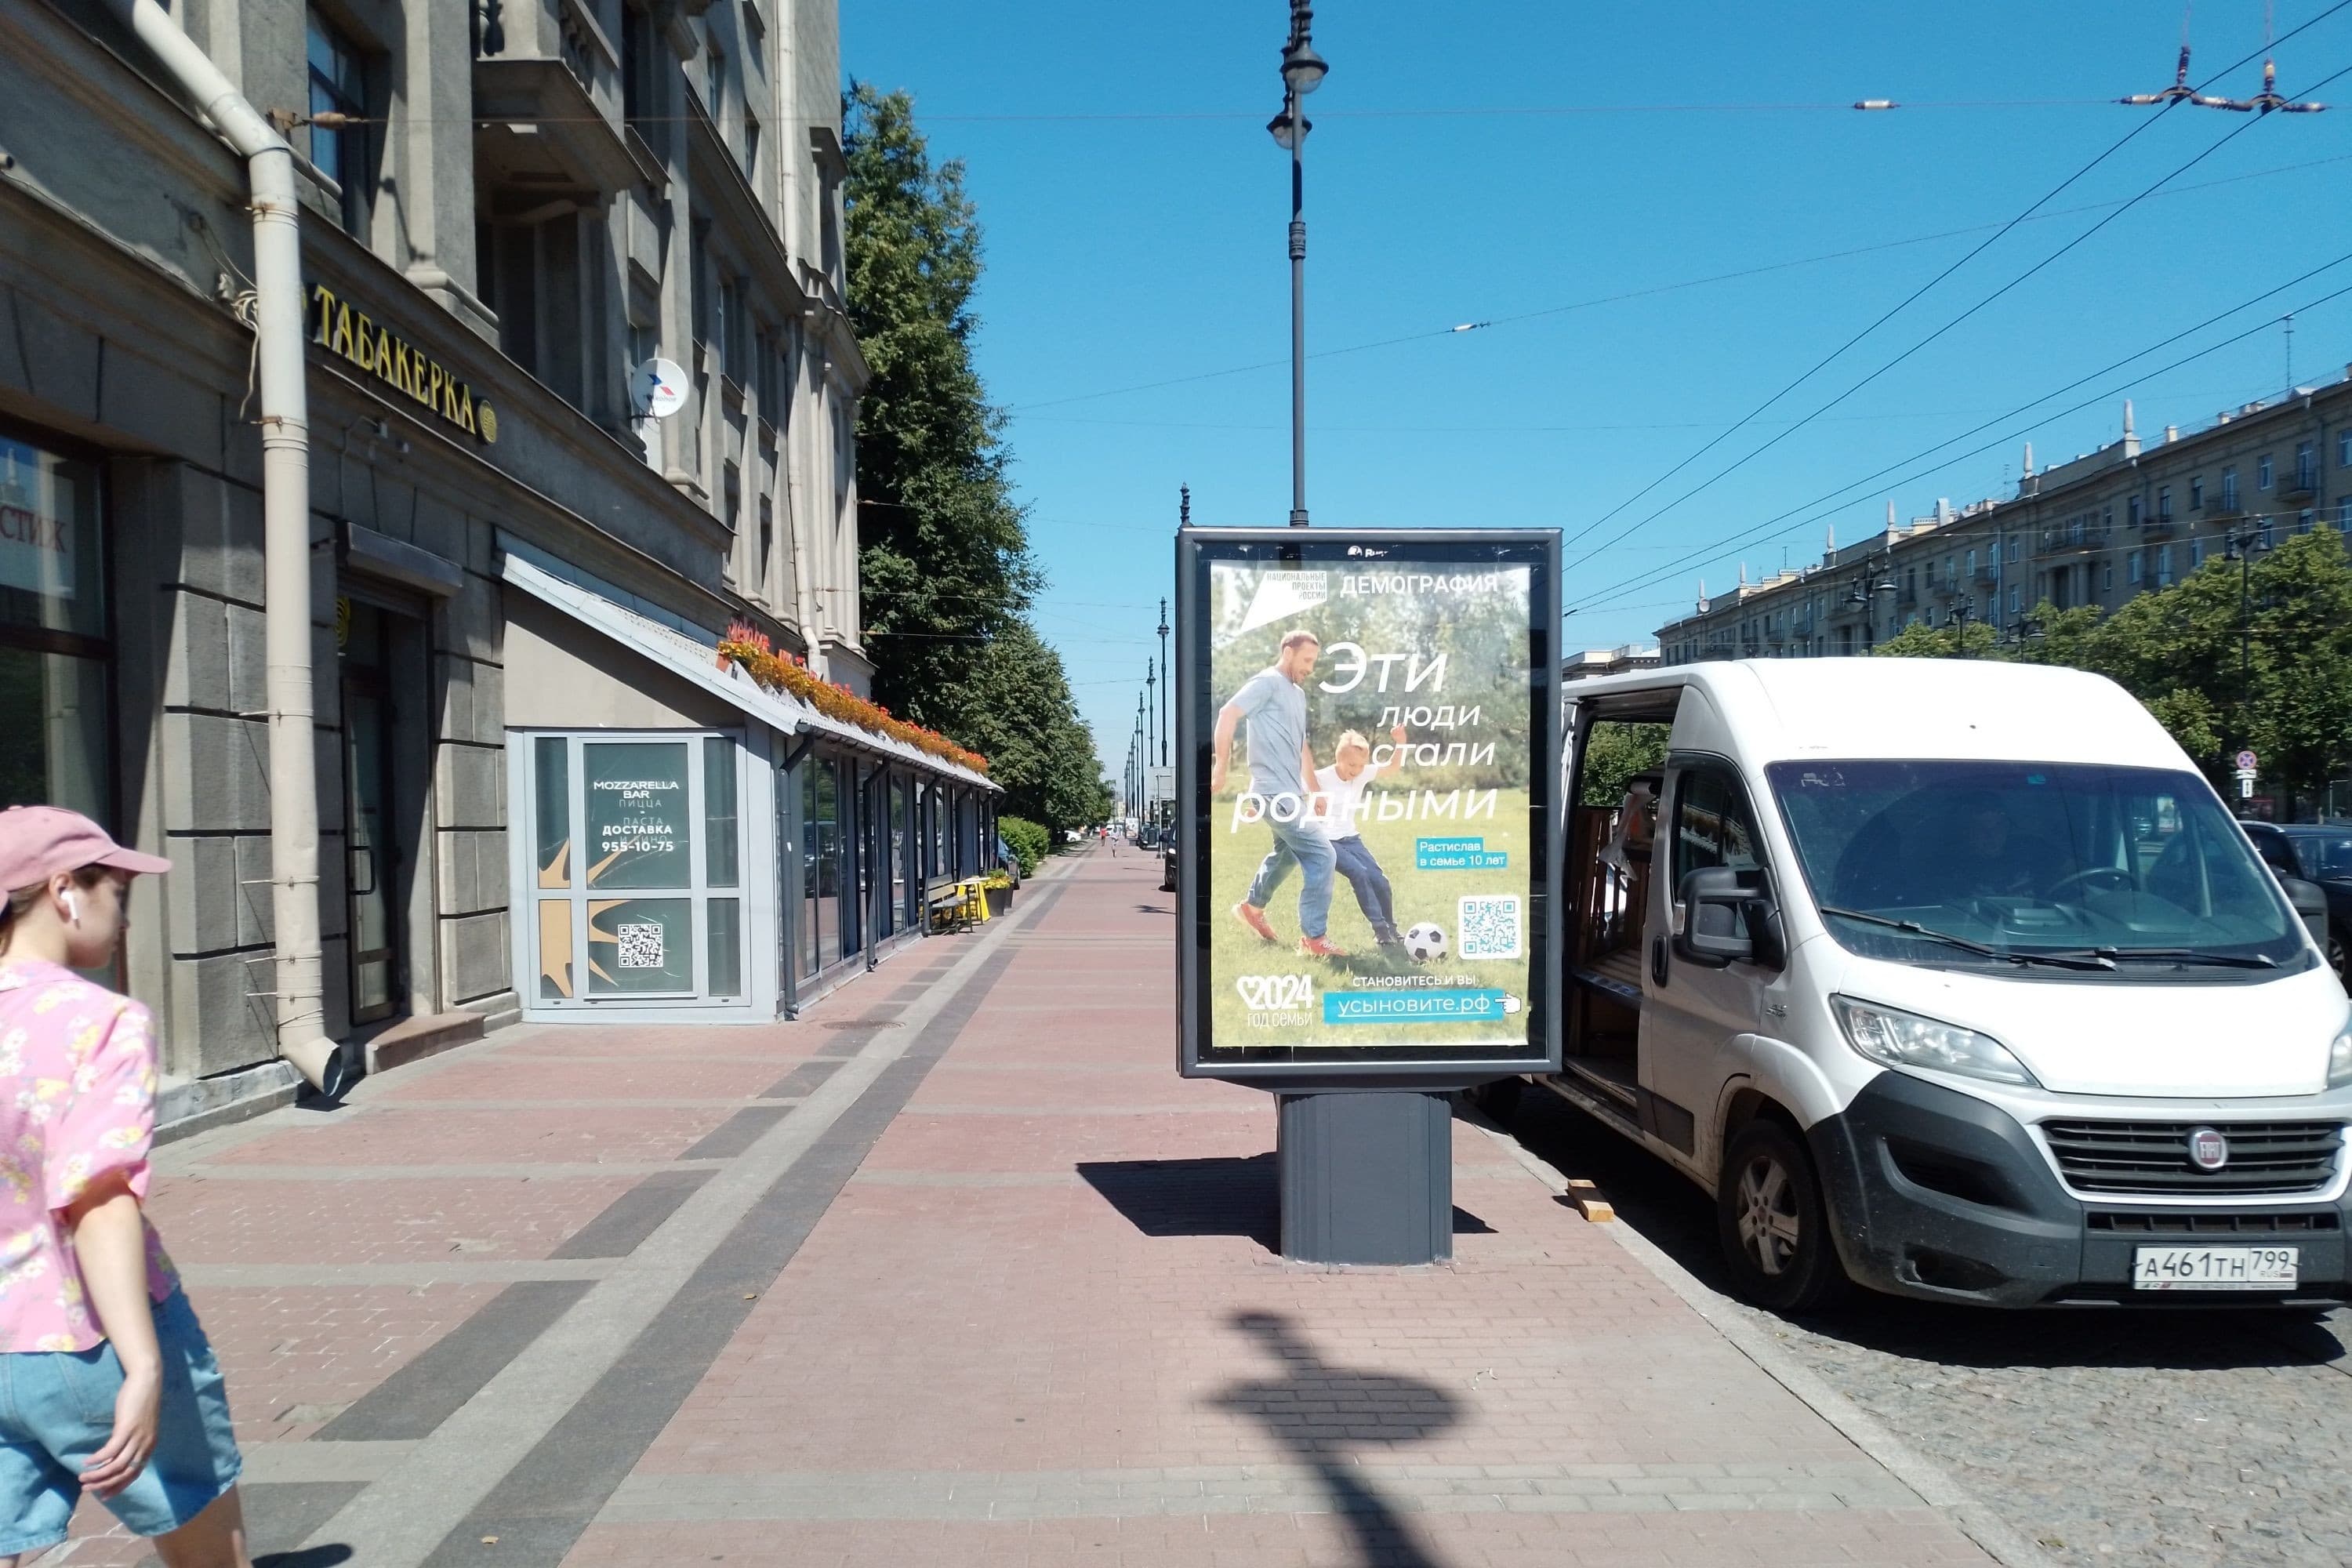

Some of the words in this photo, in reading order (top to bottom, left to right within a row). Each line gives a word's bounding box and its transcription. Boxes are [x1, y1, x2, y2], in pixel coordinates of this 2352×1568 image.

[314, 285, 476, 434] ТАБАКЕРКА
[1267, 572, 1326, 583] НАЦИОНАЛЬНЫЕ
[1292, 582, 1326, 591] ПРОЕКТЫ
[1340, 574, 1498, 598] ДЕМОГРАФИЯ
[1298, 590, 1326, 601] РОССИИ
[1318, 641, 1448, 694] Эти
[1377, 705, 1481, 731] люди
[1372, 742, 1496, 768] стали
[593, 781, 679, 789] MOZZARELLA
[623, 790, 650, 799] BAR
[619, 799, 662, 808] ПИЦЦА
[1230, 788, 1499, 834] родными
[623, 817, 664, 826] ПАСТА
[602, 826, 673, 836] ДОСТАВКА
[601, 841, 674, 852] 955-10-75
[1419, 840, 1481, 853] Растислав
[1419, 858, 1427, 866] в
[1429, 858, 1466, 866] семье
[1469, 855, 1483, 866] 10
[1485, 856, 1505, 866] лет
[1352, 976, 1442, 987] СТАНОВИТЕСЬ
[1445, 975, 1454, 985] И
[1457, 975, 1476, 985] ВЫ
[1240, 975, 1315, 1011] 2024
[1338, 993, 1490, 1018] усыновите.рф
[2251, 1250, 2289, 1270] 799
